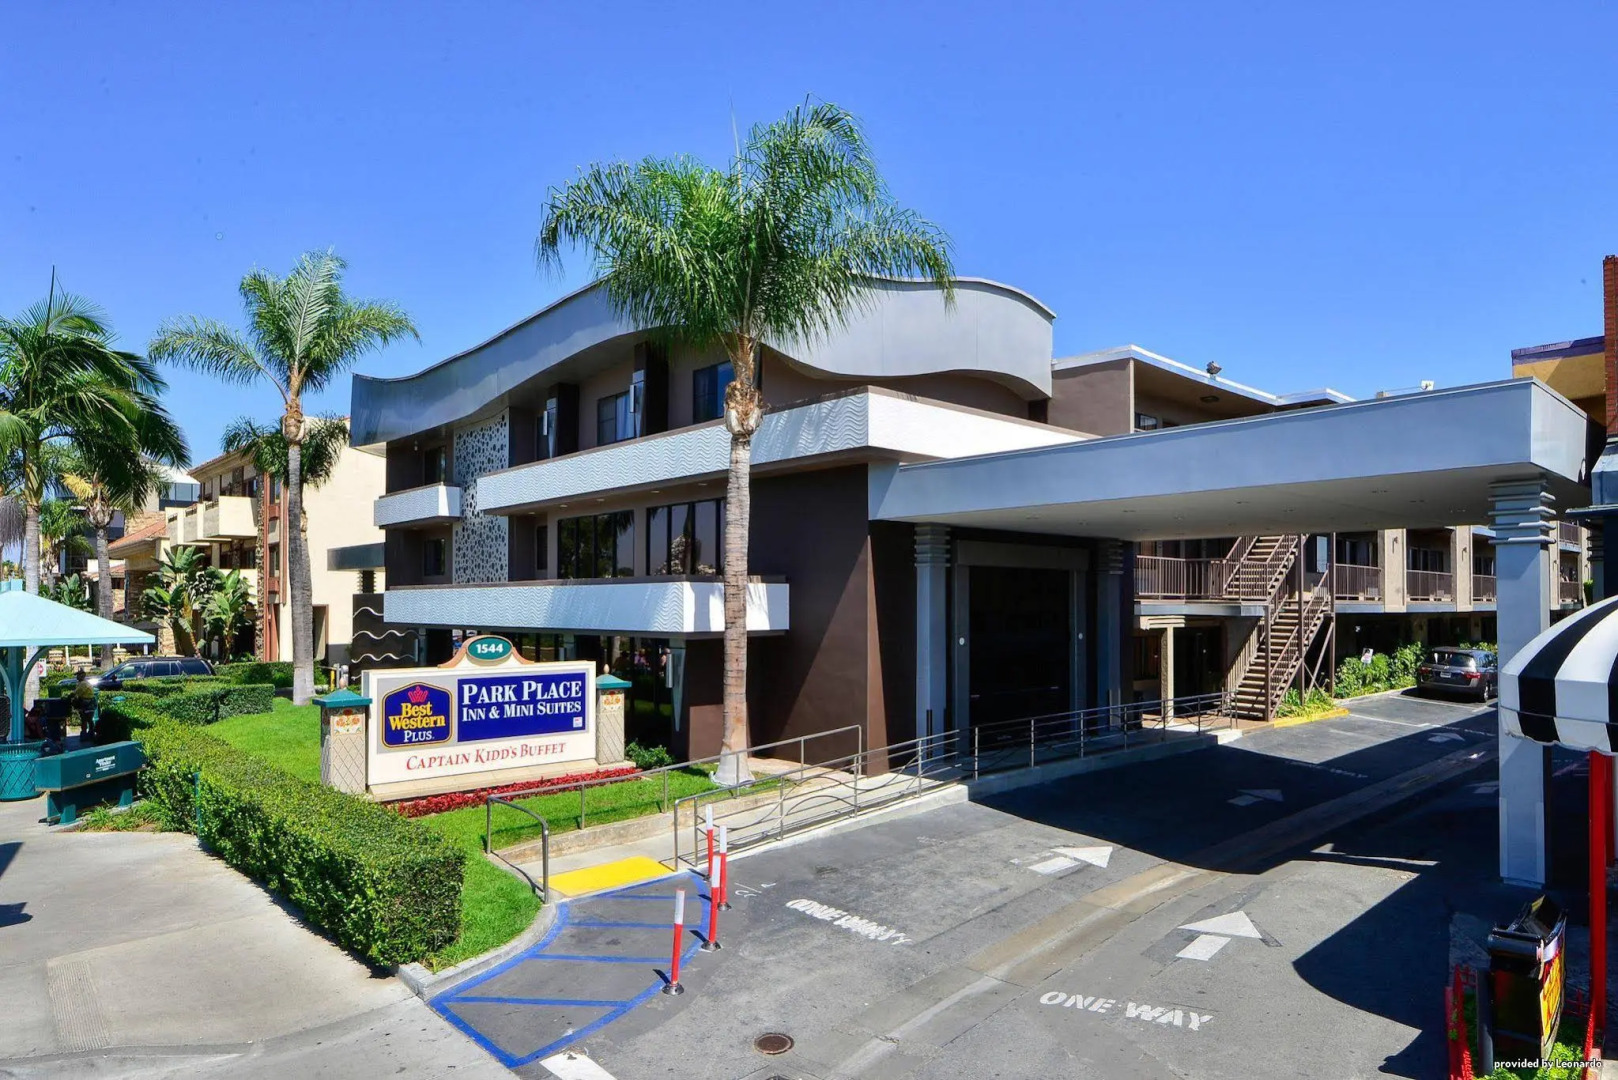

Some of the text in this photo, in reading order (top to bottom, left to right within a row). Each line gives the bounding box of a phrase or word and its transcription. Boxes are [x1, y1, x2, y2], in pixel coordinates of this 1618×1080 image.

[475, 643, 504, 655] 1544
[461, 680, 583, 706] PARK PLACE
[400, 702, 433, 717] Best
[462, 700, 582, 722] INN & MINI SUITES
[388, 713, 446, 731] Western
[403, 730, 433, 743] PLUS
[406, 751, 470, 771] CAPTAIN
[519, 742, 567, 758] BUFFET
[1039, 991, 1214, 1031] ONE WAY
